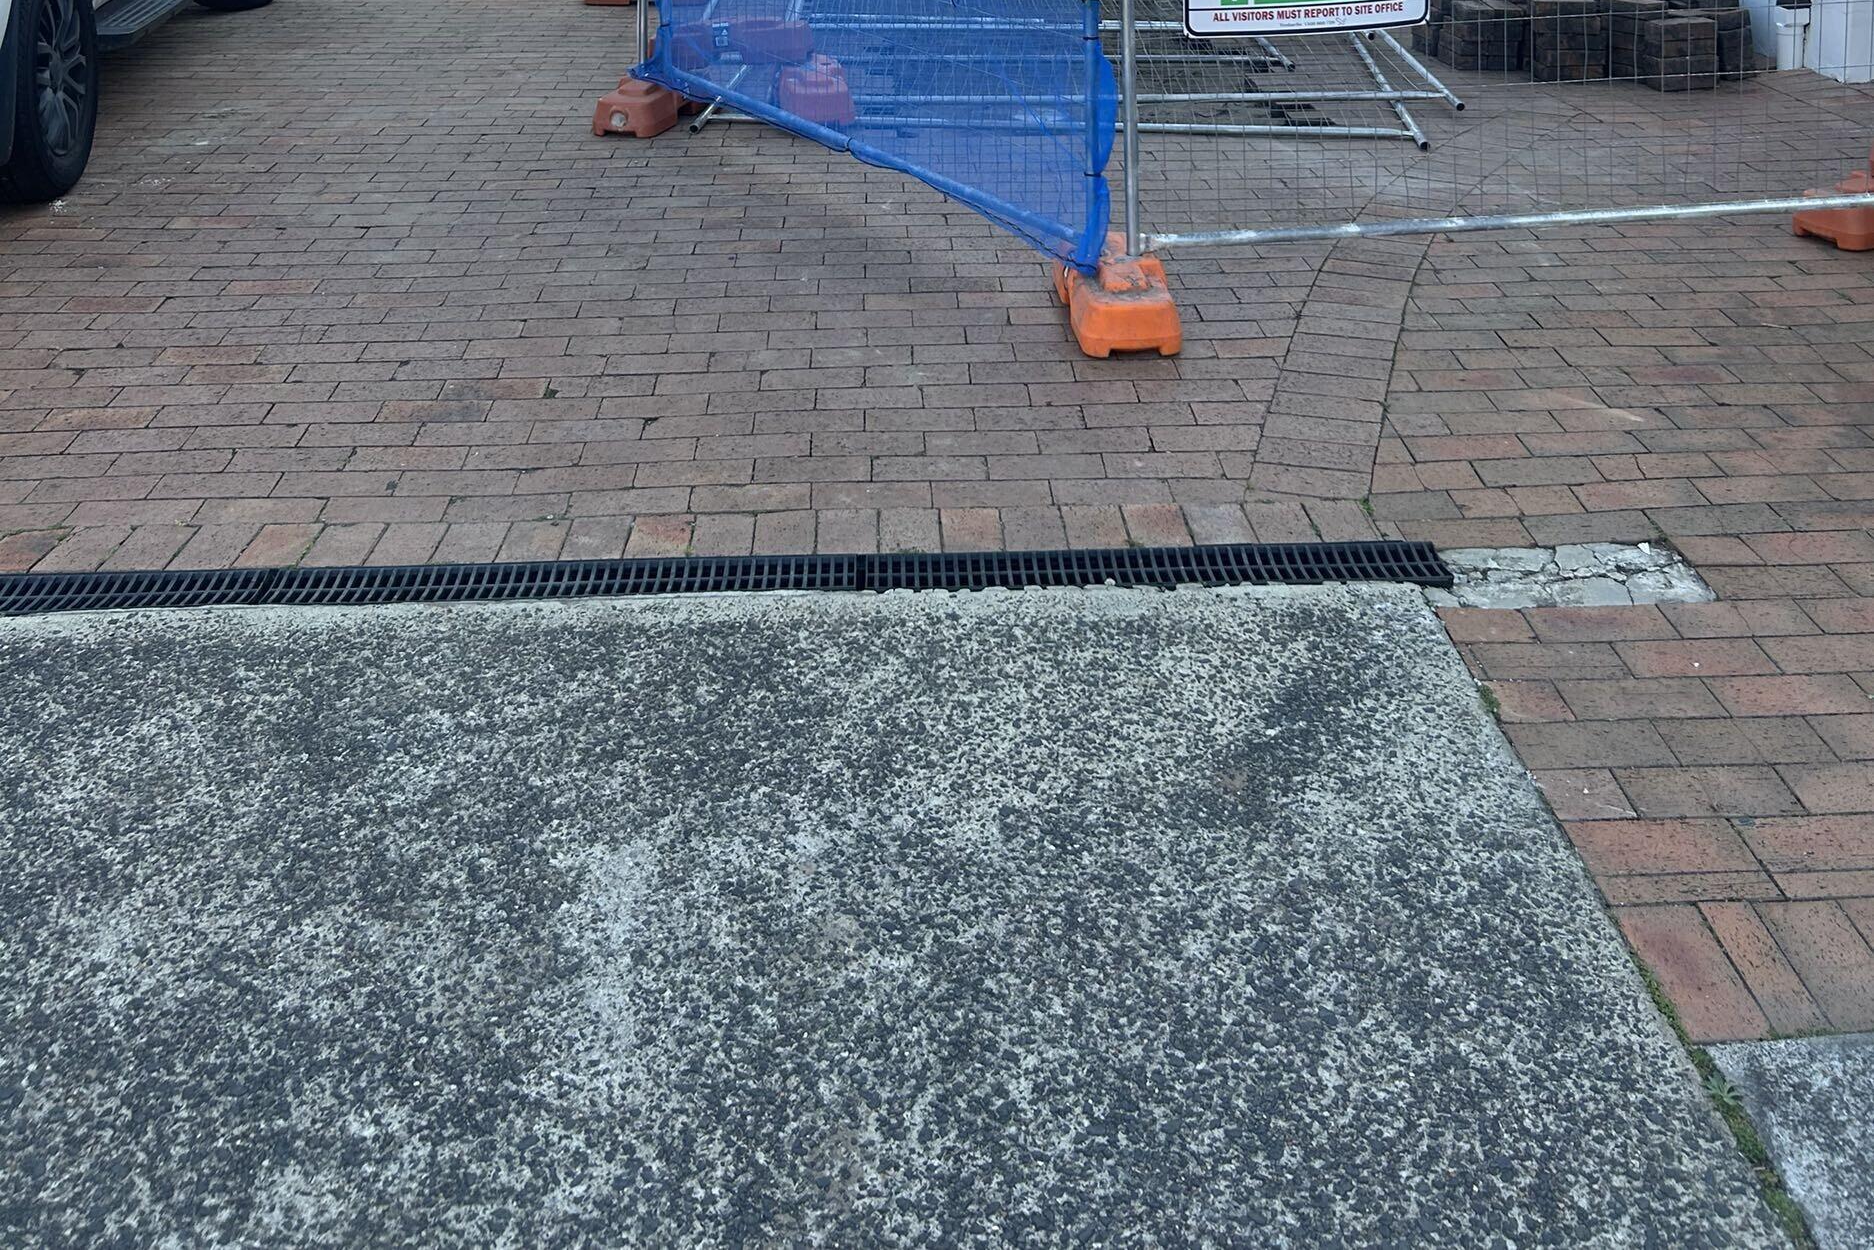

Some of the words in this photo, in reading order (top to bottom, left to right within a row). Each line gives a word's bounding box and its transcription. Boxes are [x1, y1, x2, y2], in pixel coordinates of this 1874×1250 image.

[1213, 12, 1230, 22] ALL
[1231, 9, 1274, 21] VISITORS
[1277, 9, 1303, 20] MUST
[1304, 5, 1340, 18] REPORT
[1340, 5, 1353, 16] TO
[1354, 3, 1373, 15] SITE
[1374, 1, 1404, 13] OFFICE
